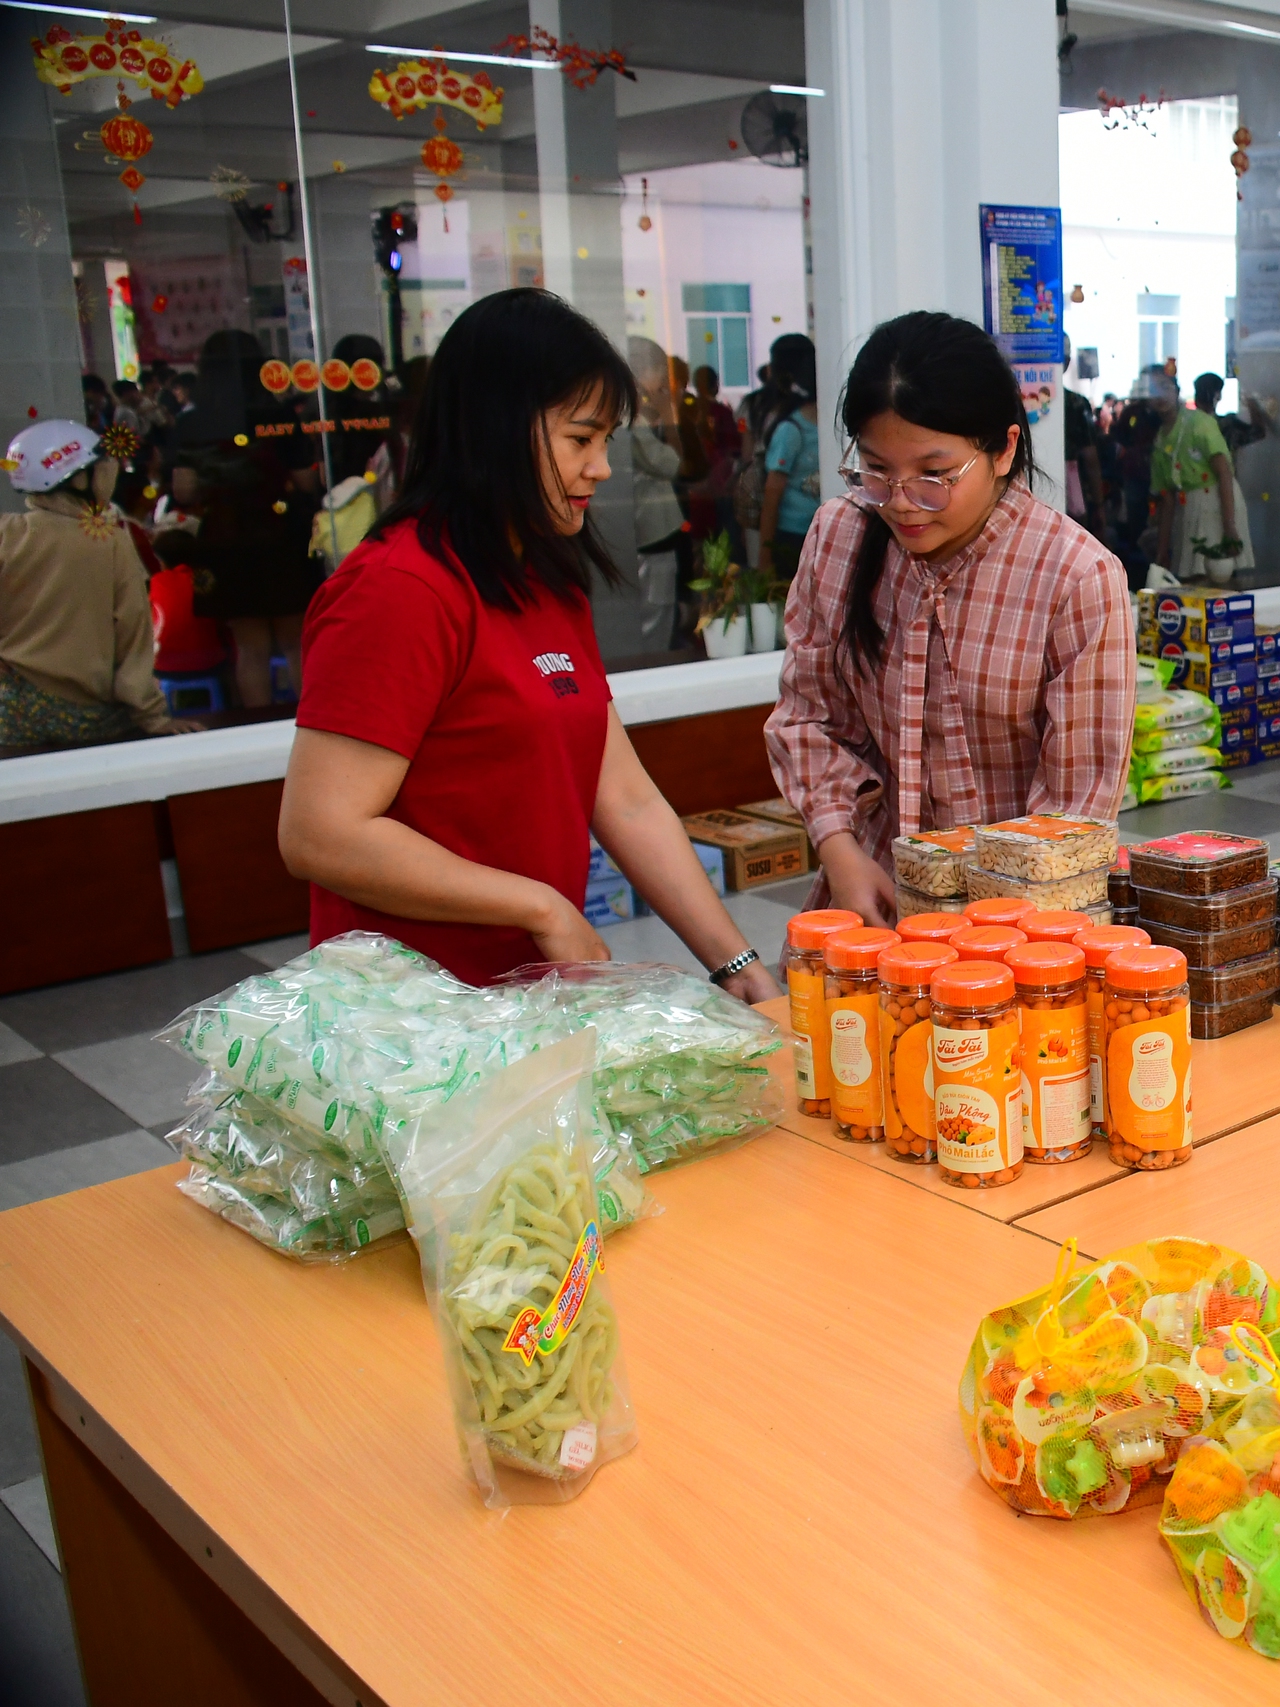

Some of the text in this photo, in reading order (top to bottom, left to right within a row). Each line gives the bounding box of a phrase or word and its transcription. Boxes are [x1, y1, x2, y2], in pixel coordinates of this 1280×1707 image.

[746, 859, 771, 878] SUSU
[937, 1036, 982, 1054] Tài Tài
[940, 1102, 991, 1122] Đậu Phộng
[939, 1142, 994, 1158] Phô Mai Lắc
[543, 1312, 561, 1340] Chúc
[558, 1281, 577, 1313] Mừng
[571, 1256, 585, 1281] Năm
[569, 1446, 580, 1455] GEL
[575, 1441, 593, 1453] SILICA
